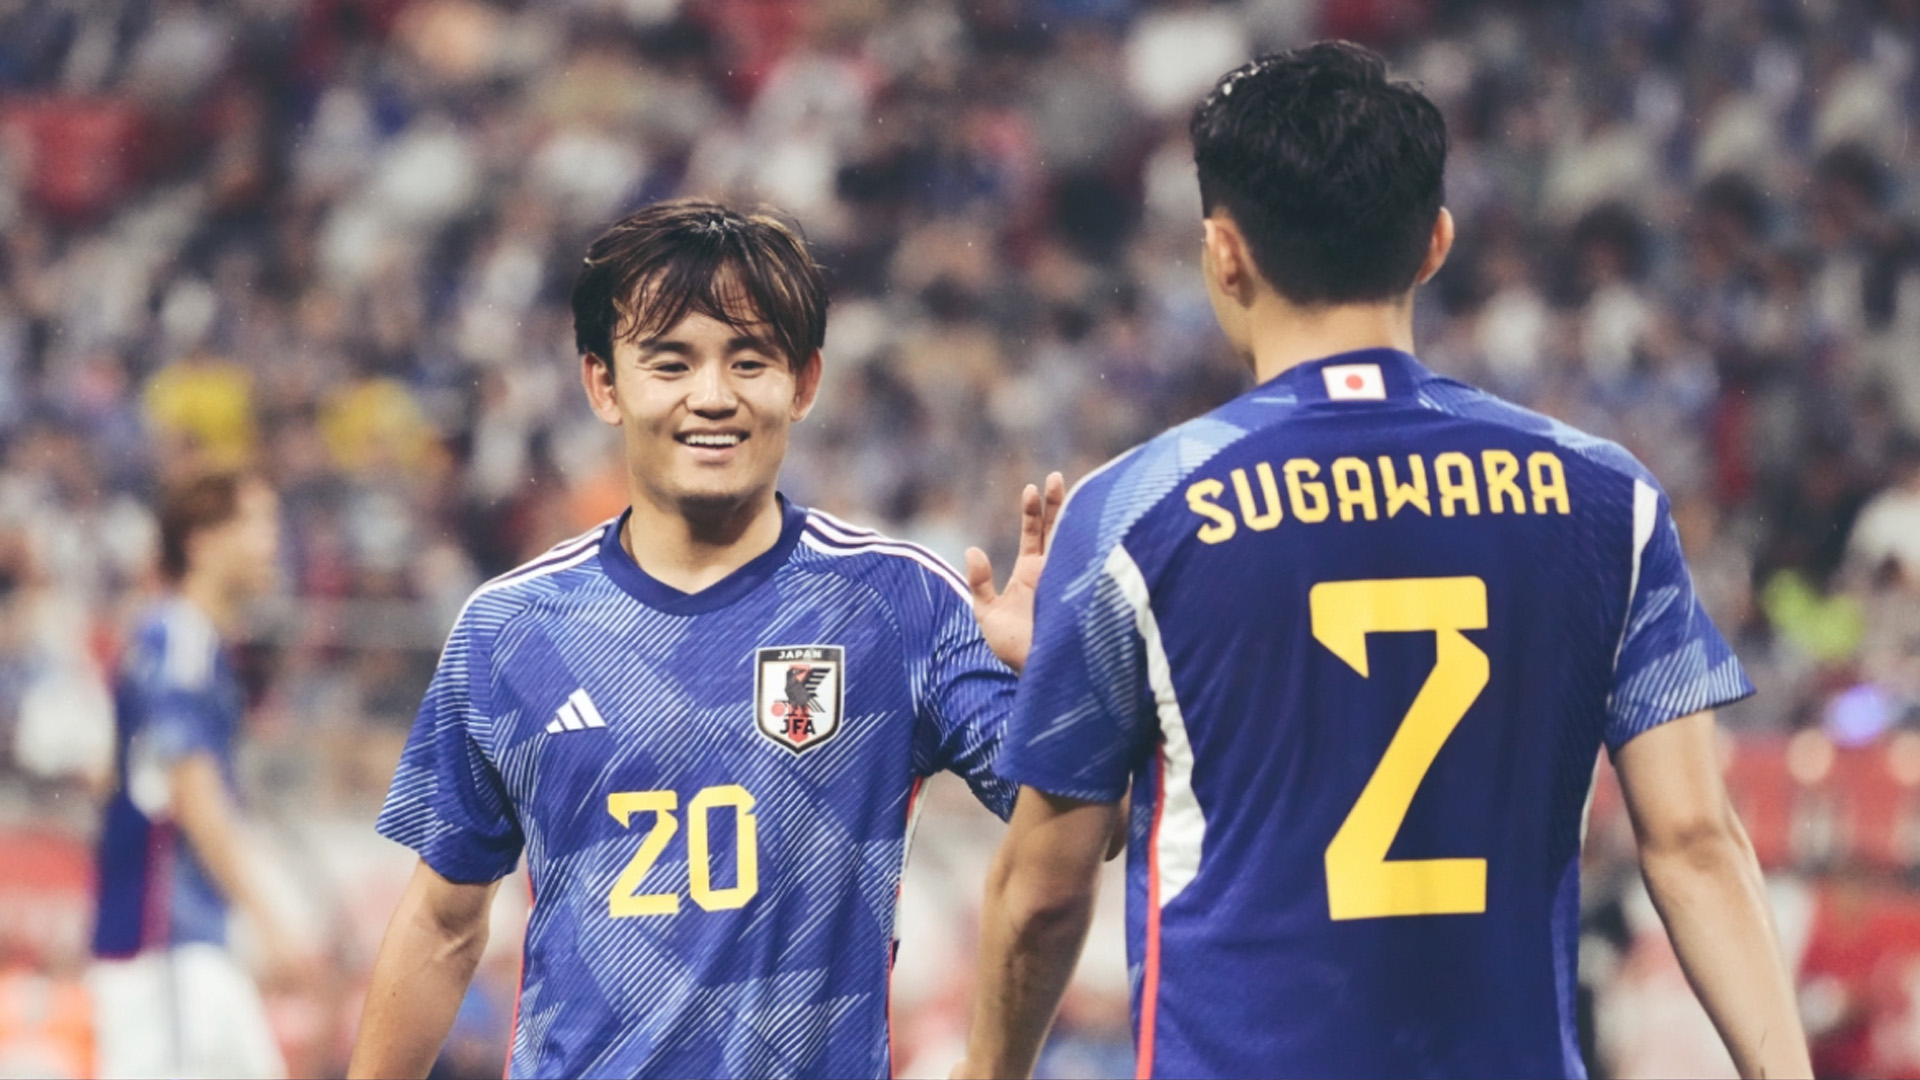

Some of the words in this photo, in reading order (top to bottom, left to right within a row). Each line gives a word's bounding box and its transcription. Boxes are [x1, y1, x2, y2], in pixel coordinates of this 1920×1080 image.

[1185, 449, 1571, 544] SUGAWARA
[778, 650, 822, 659] JAPAN
[779, 719, 816, 735] JFA
[1309, 576, 1490, 921] 2
[607, 784, 759, 919] 20
